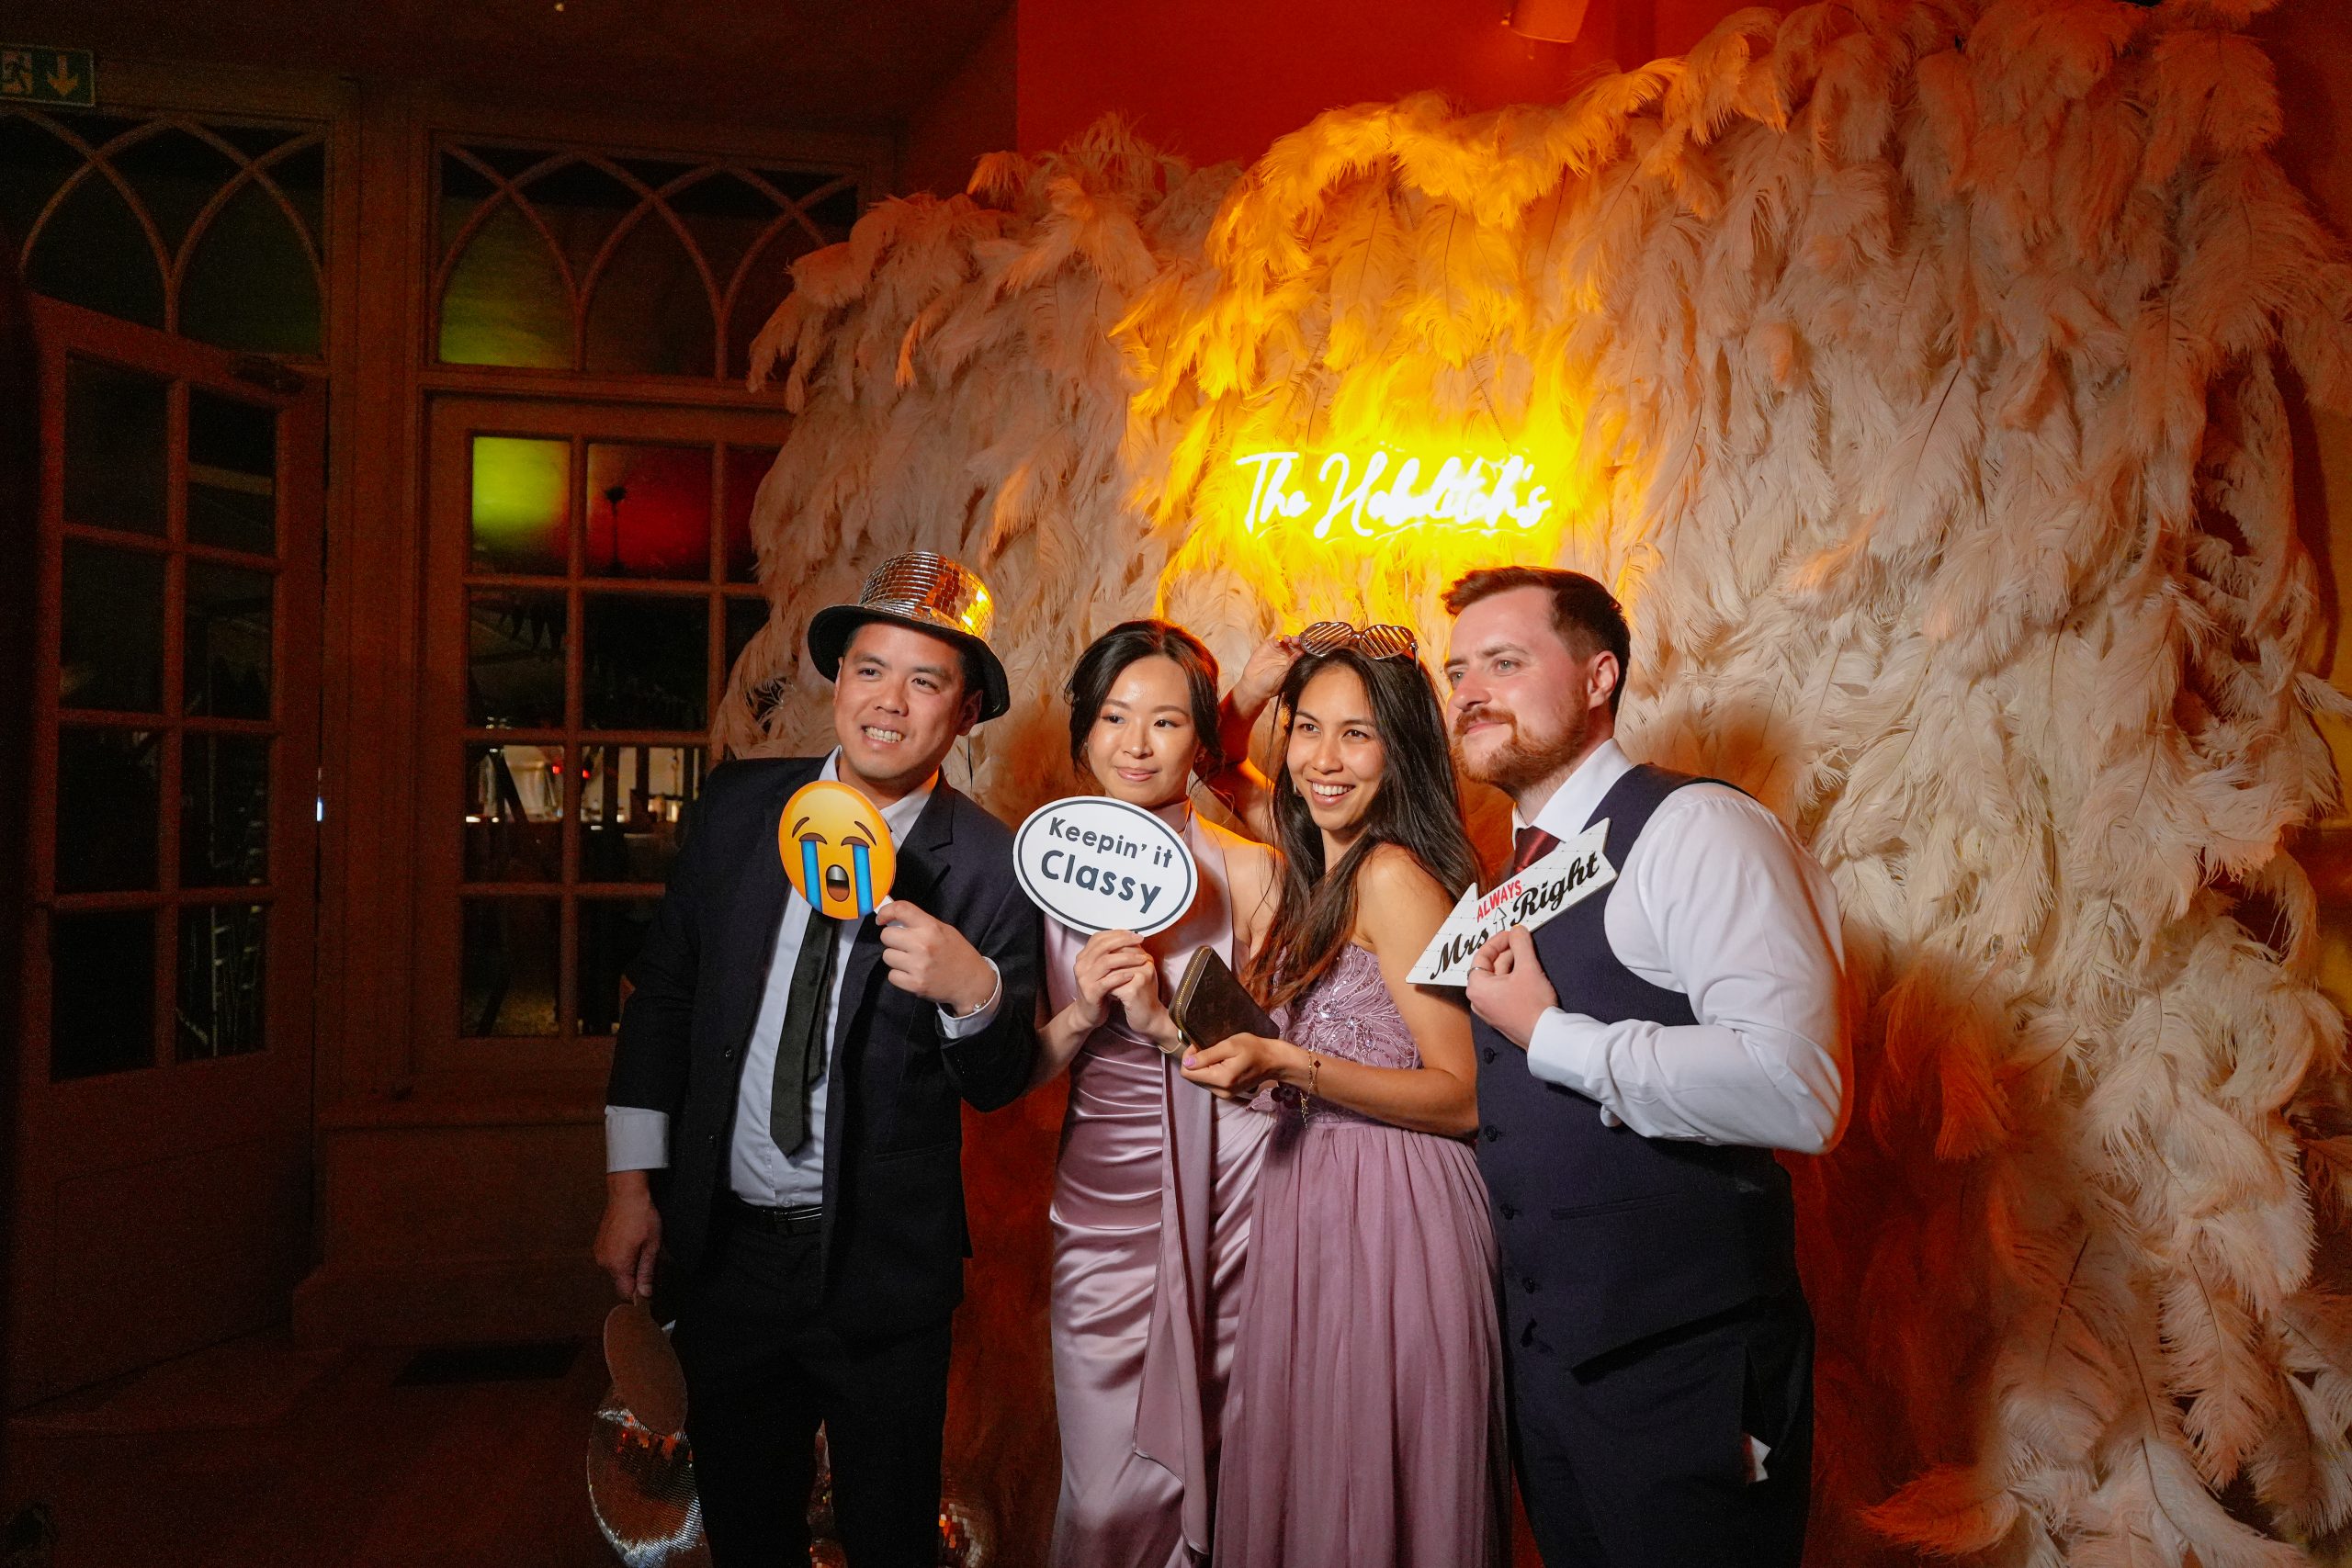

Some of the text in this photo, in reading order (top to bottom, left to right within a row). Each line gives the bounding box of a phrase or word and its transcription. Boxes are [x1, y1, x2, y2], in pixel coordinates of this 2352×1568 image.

[1236, 452, 1311, 533] The
[1041, 850, 1162, 914] Classy
[1153, 845, 1173, 868] it
[1430, 851, 1600, 980] Mrs Right
[1476, 880, 1522, 923] ALWAYS
